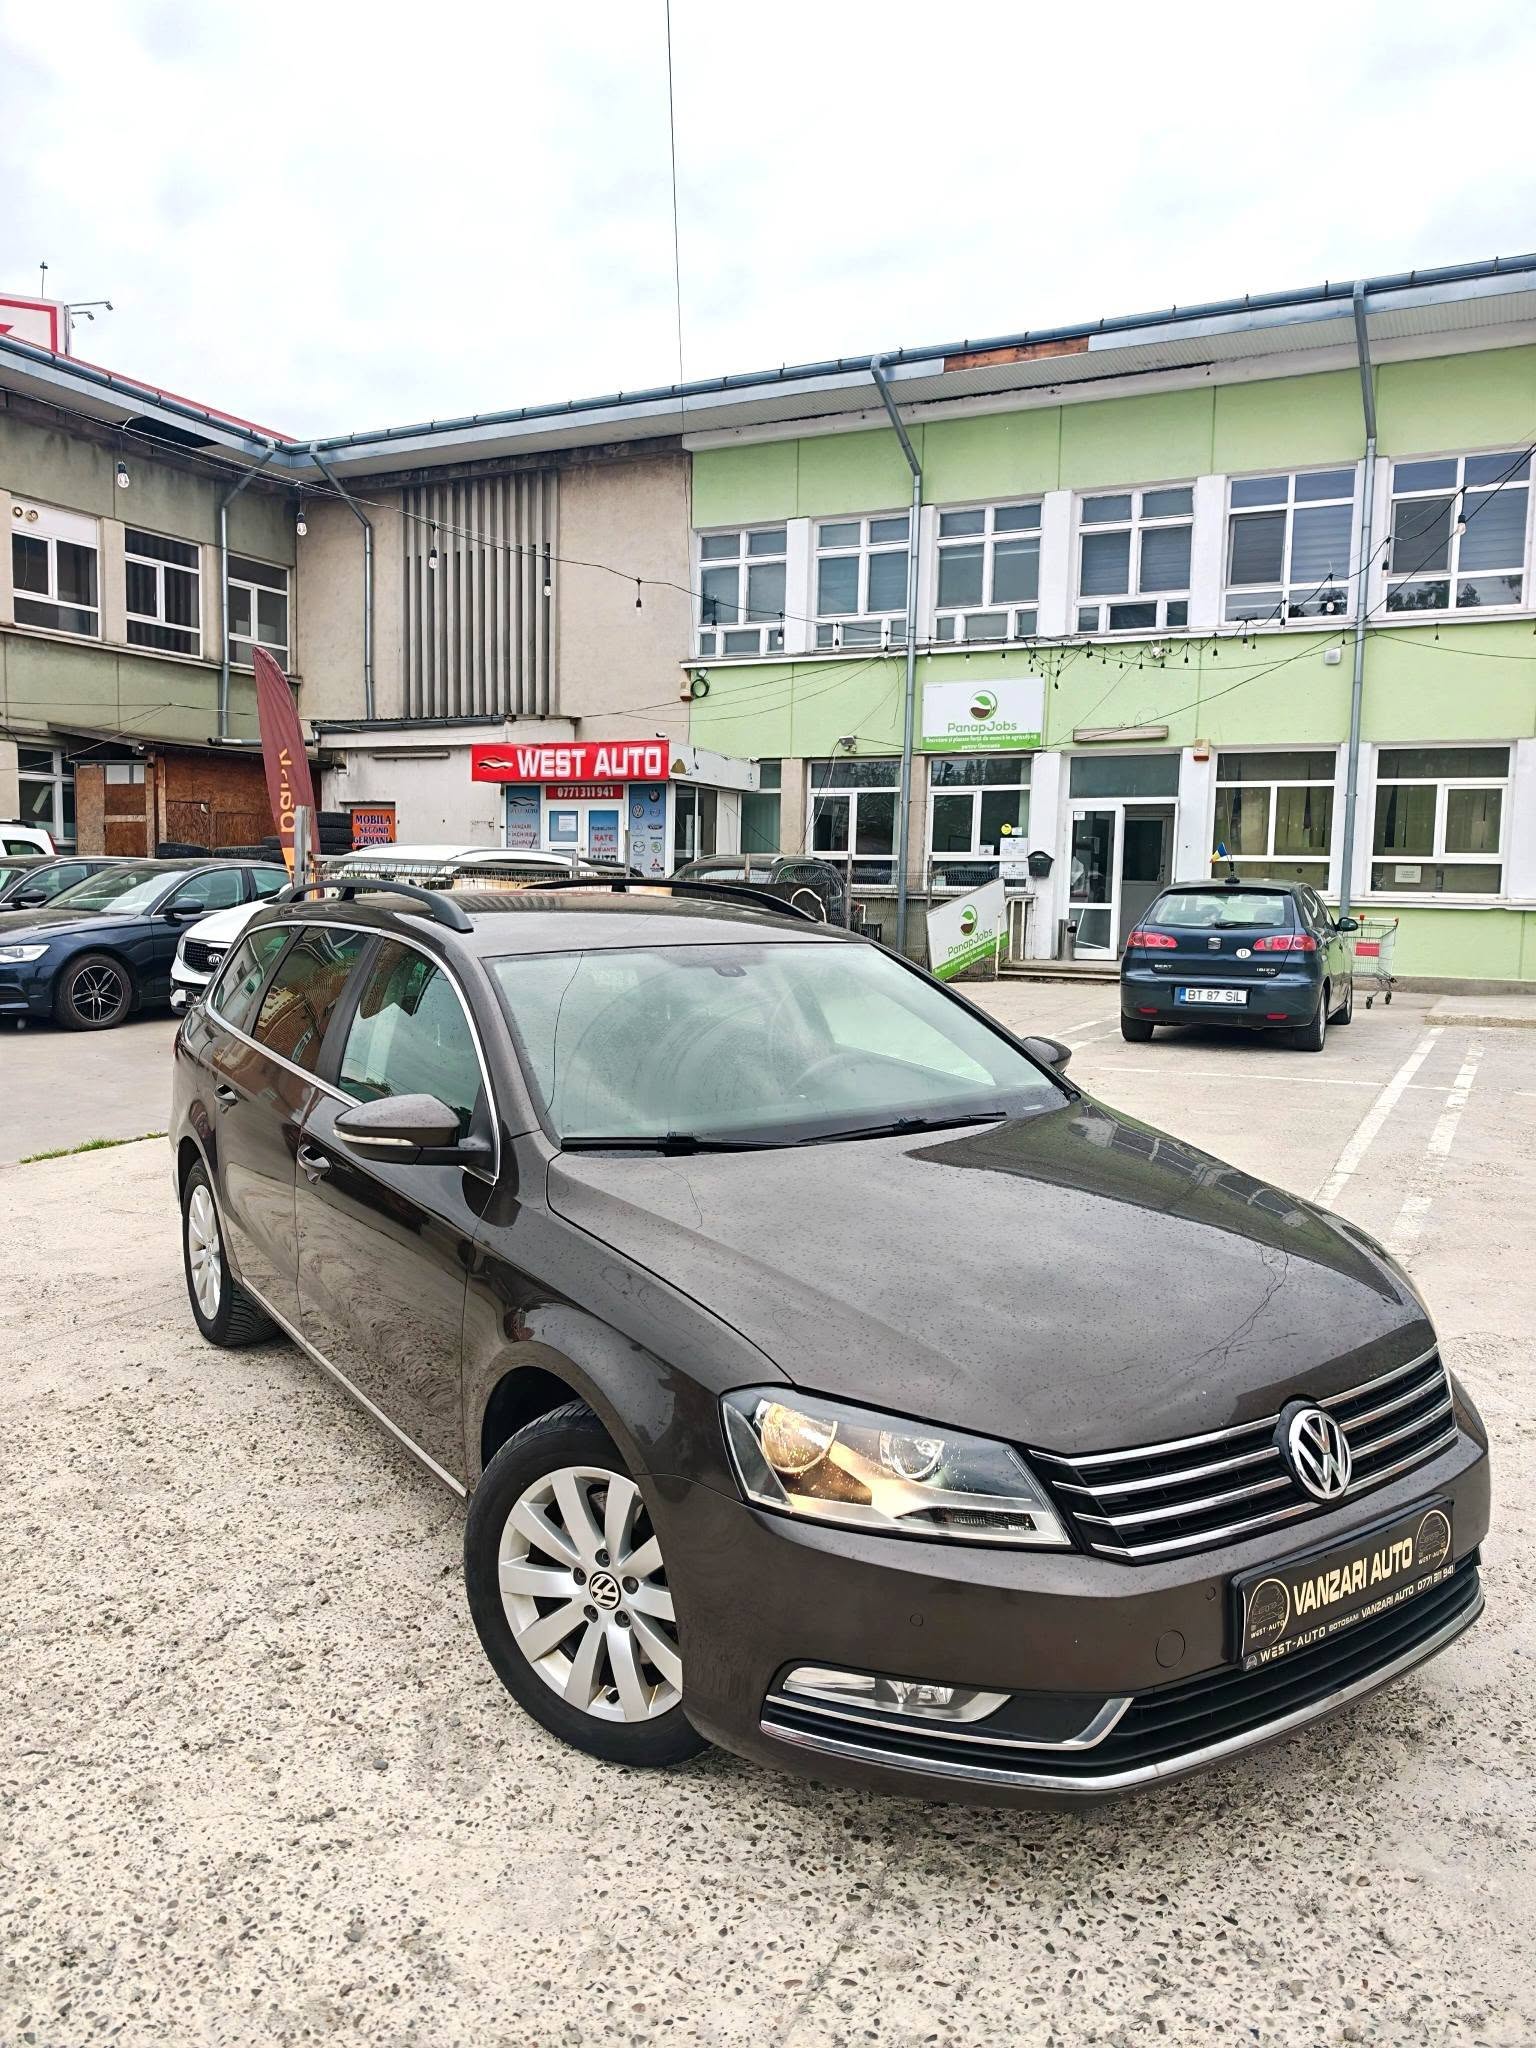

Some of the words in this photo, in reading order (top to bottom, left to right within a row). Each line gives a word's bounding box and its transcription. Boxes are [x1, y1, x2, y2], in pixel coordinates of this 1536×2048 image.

[947, 721, 1017, 734] PanapJobs
[516, 748, 586, 778] WEST
[594, 746, 662, 777] AUTO
[557, 786, 614, 798] 0771311941
[355, 814, 392, 825] MOBILA
[359, 826, 389, 835] SECOND
[353, 836, 393, 844] GERMANIA
[947, 928, 993, 957] PanapJobs
[208, 955, 220, 963] KIA
[1188, 990, 1203, 1000] BT
[1206, 991, 1220, 1001] 87
[1226, 991, 1243, 1002] SIL
[1418, 1547, 1446, 1565] WEST-AUTO
[1293, 1557, 1367, 1616] VANZARI
[1370, 1537, 1413, 1585] AUTO
[1260, 1626, 1326, 1662] WEST-AUTO
[1361, 1596, 1394, 1618] VANZARI
[1394, 1585, 1414, 1603] AUTO
[1417, 1576, 1433, 1590] 0771
[1443, 1565, 1454, 1578] 941
[1250, 1620, 1285, 1639] WEST-AUTO
